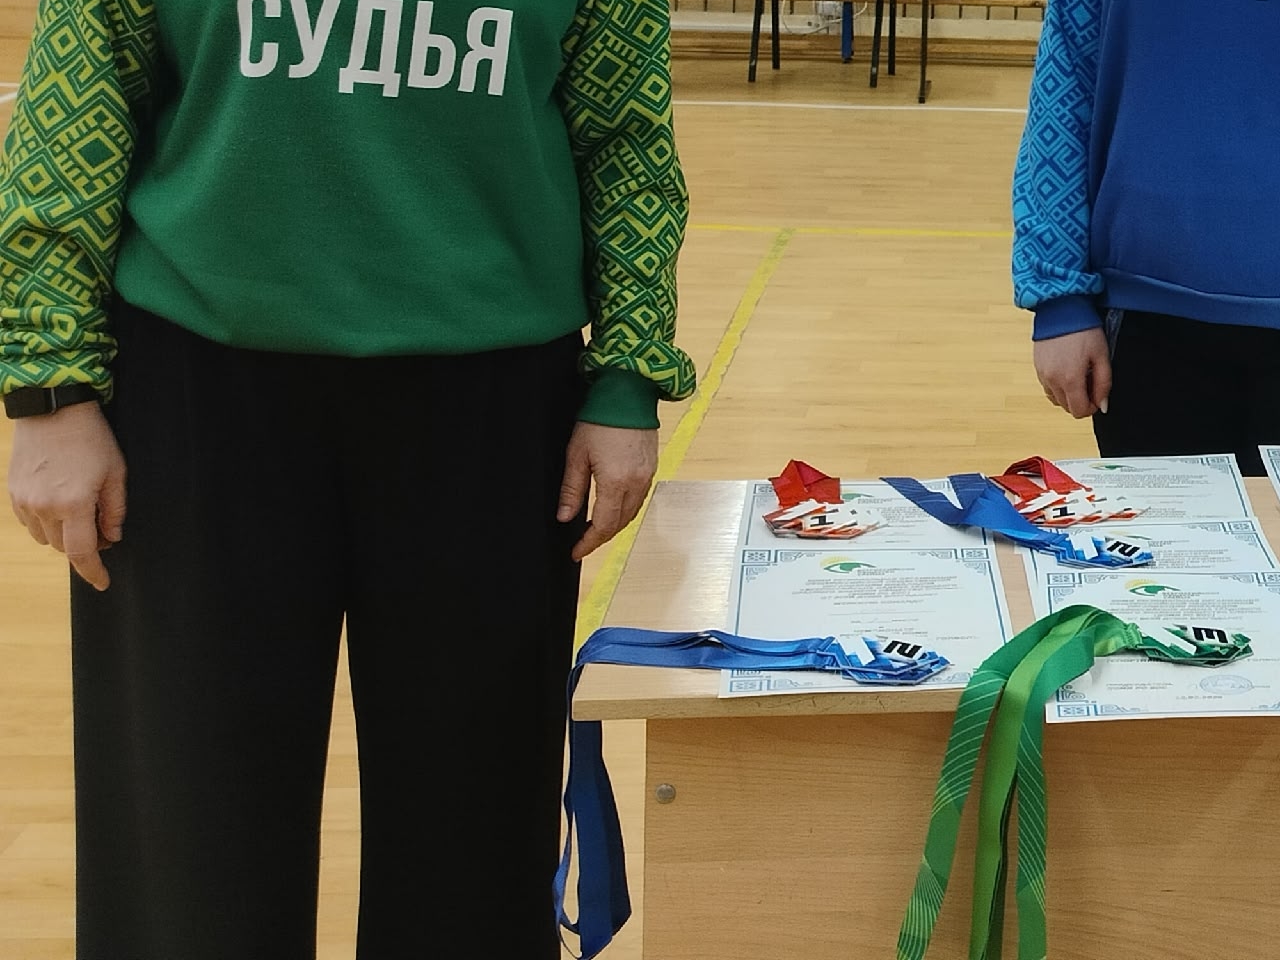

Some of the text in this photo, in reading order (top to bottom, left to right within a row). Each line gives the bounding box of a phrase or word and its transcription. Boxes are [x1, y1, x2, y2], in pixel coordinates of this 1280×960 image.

[1106, 540, 1140, 557] 2
[1192, 626, 1229, 644] 3
[883, 639, 923, 659] 2
